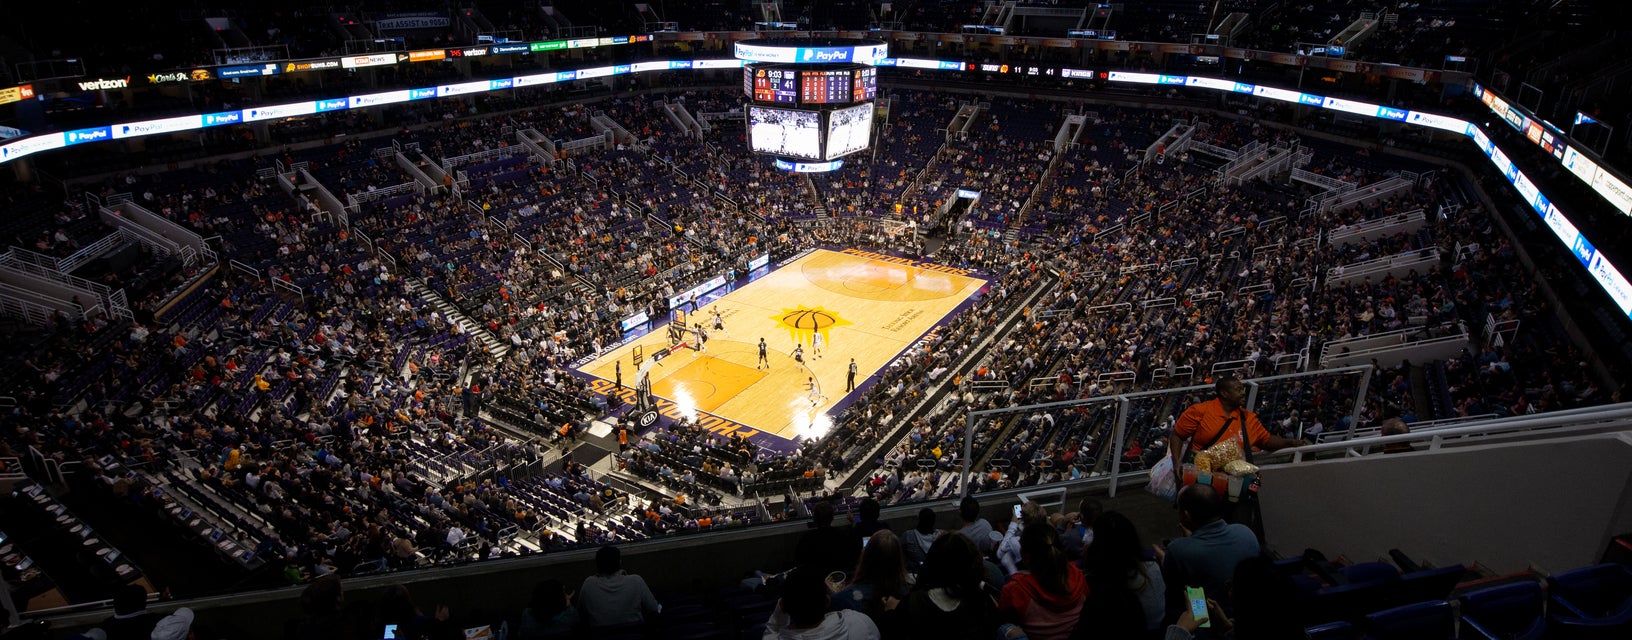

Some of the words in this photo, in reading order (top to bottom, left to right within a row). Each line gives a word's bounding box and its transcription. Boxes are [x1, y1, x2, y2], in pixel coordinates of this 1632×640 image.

[463, 48, 486, 57] verizon
[816, 50, 847, 61] PayPal
[982, 64, 999, 72] SUNS
[155, 72, 176, 83] Carl's
[767, 70, 782, 79] 9:03
[79, 78, 128, 91] verizon
[757, 78, 766, 87] 11
[784, 80, 793, 89] 41
[643, 413, 655, 425] KIA
